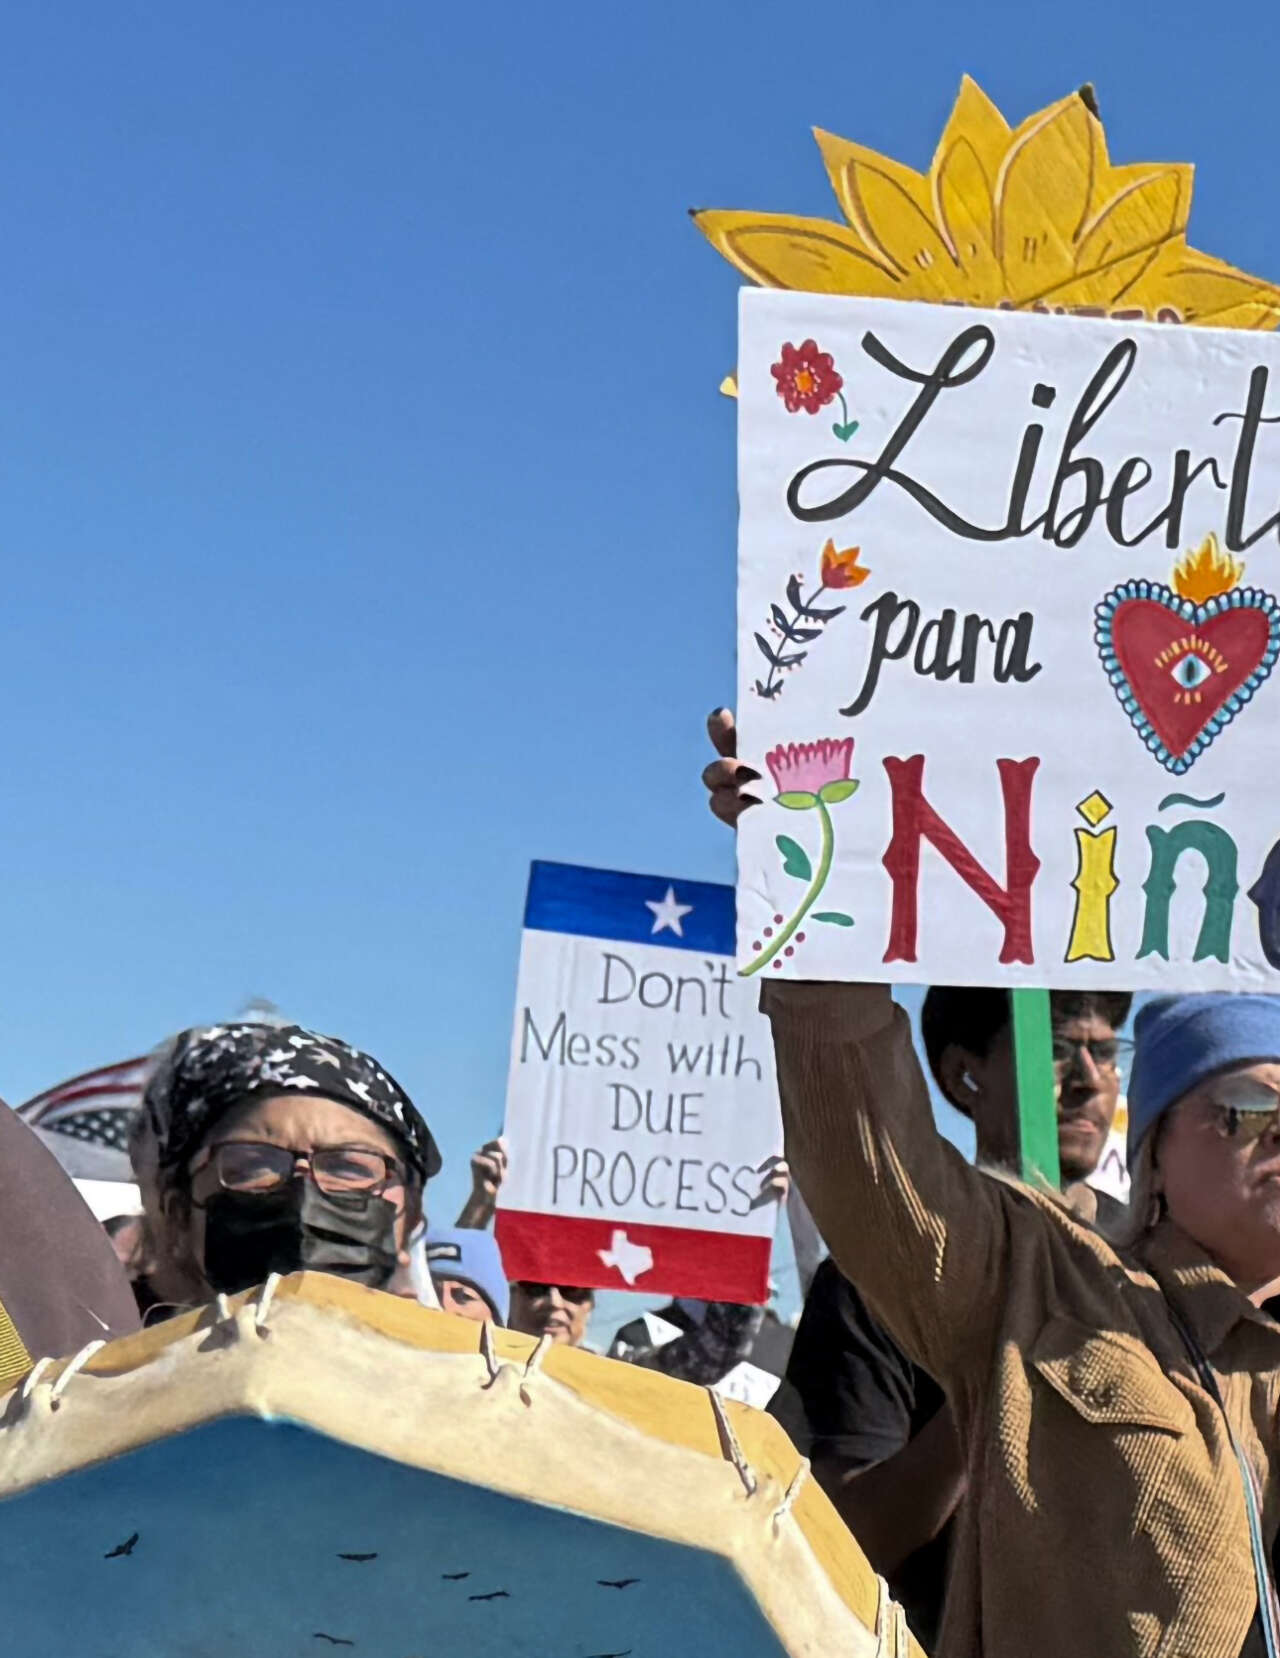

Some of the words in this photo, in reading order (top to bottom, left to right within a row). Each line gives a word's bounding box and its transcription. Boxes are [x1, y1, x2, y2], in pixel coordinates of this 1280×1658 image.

[839, 591, 1042, 717] para
[598, 952, 734, 1018] Don't
[520, 1007, 640, 1070] Mess
[608, 1083, 704, 1135] DUE
[552, 1144, 756, 1217] PROCESS
